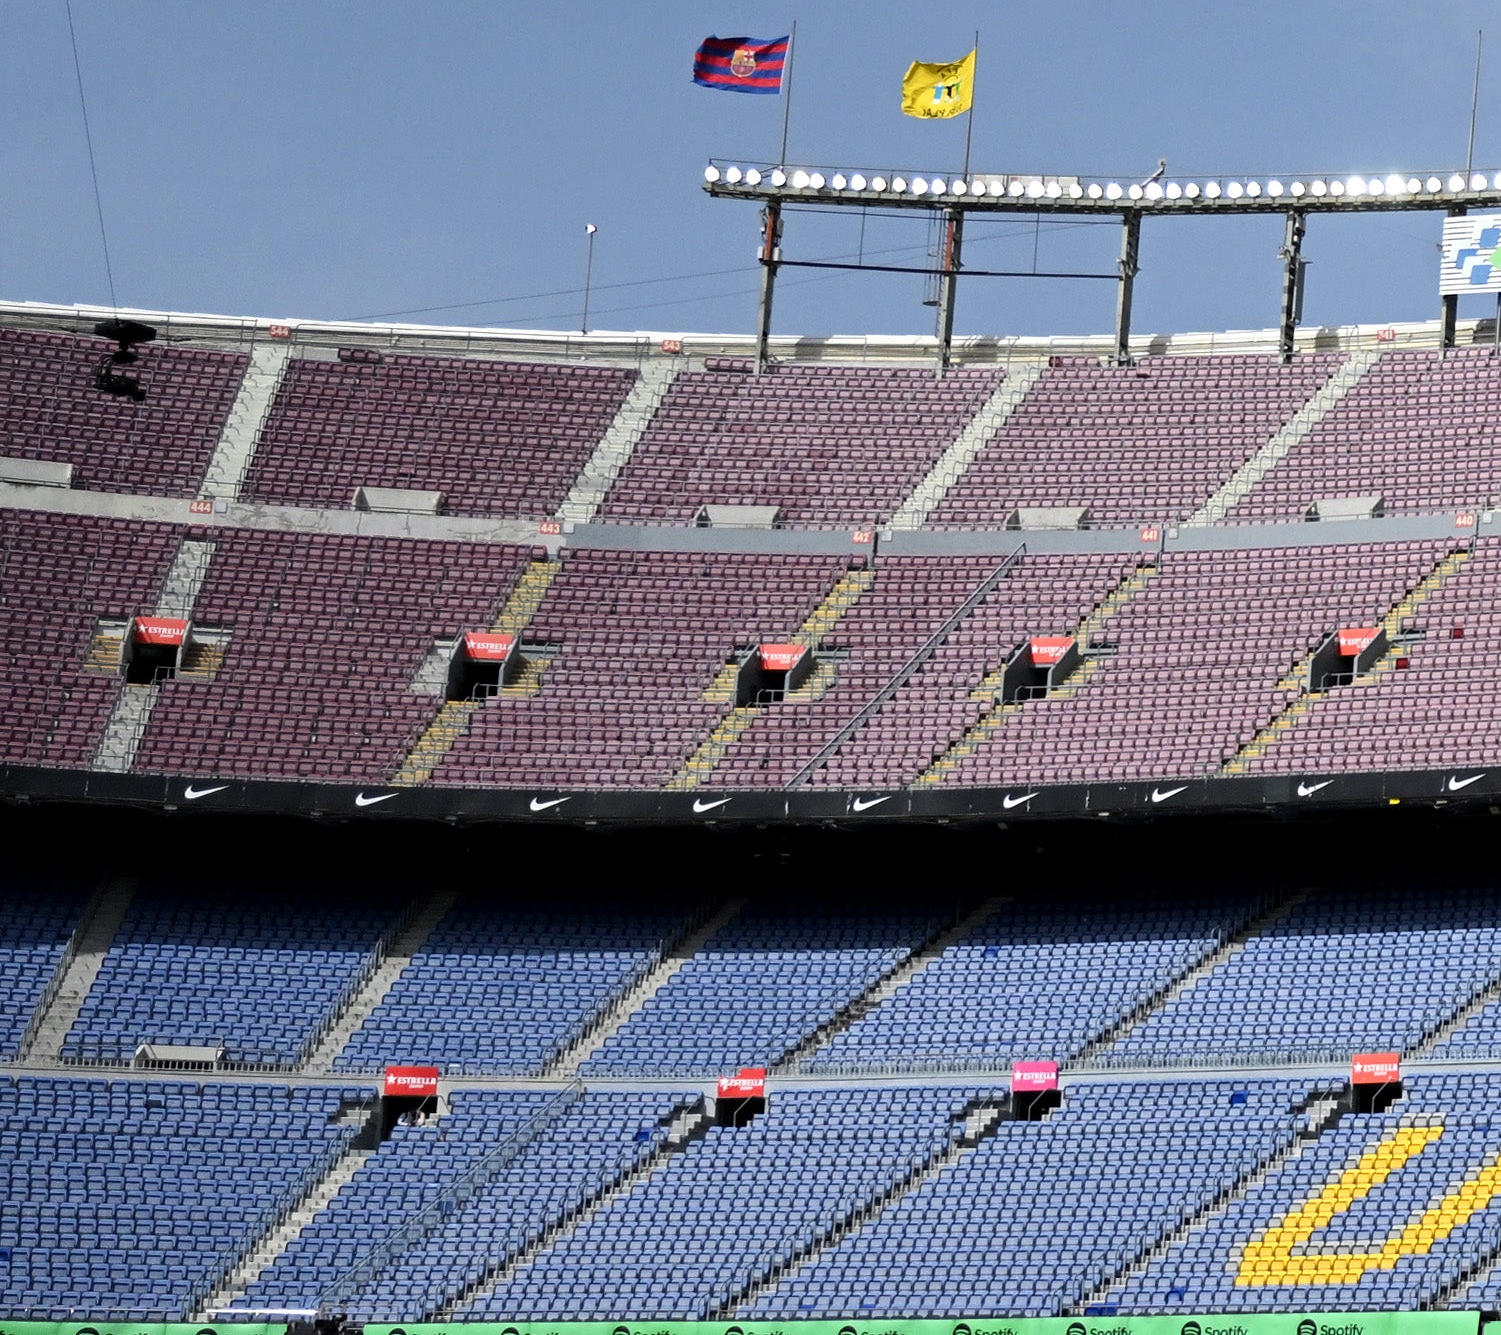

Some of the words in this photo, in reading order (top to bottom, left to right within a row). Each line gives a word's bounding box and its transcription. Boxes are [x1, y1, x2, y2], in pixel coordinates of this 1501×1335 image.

[190, 501, 211, 512] 444
[1456, 515, 1472, 526] 440
[540, 523, 560, 533] 443
[1363, 1063, 1398, 1072] ESTRELLA
[397, 1076, 437, 1085] ESTRELLA
[1022, 1072, 1056, 1080] ESTRELLA
